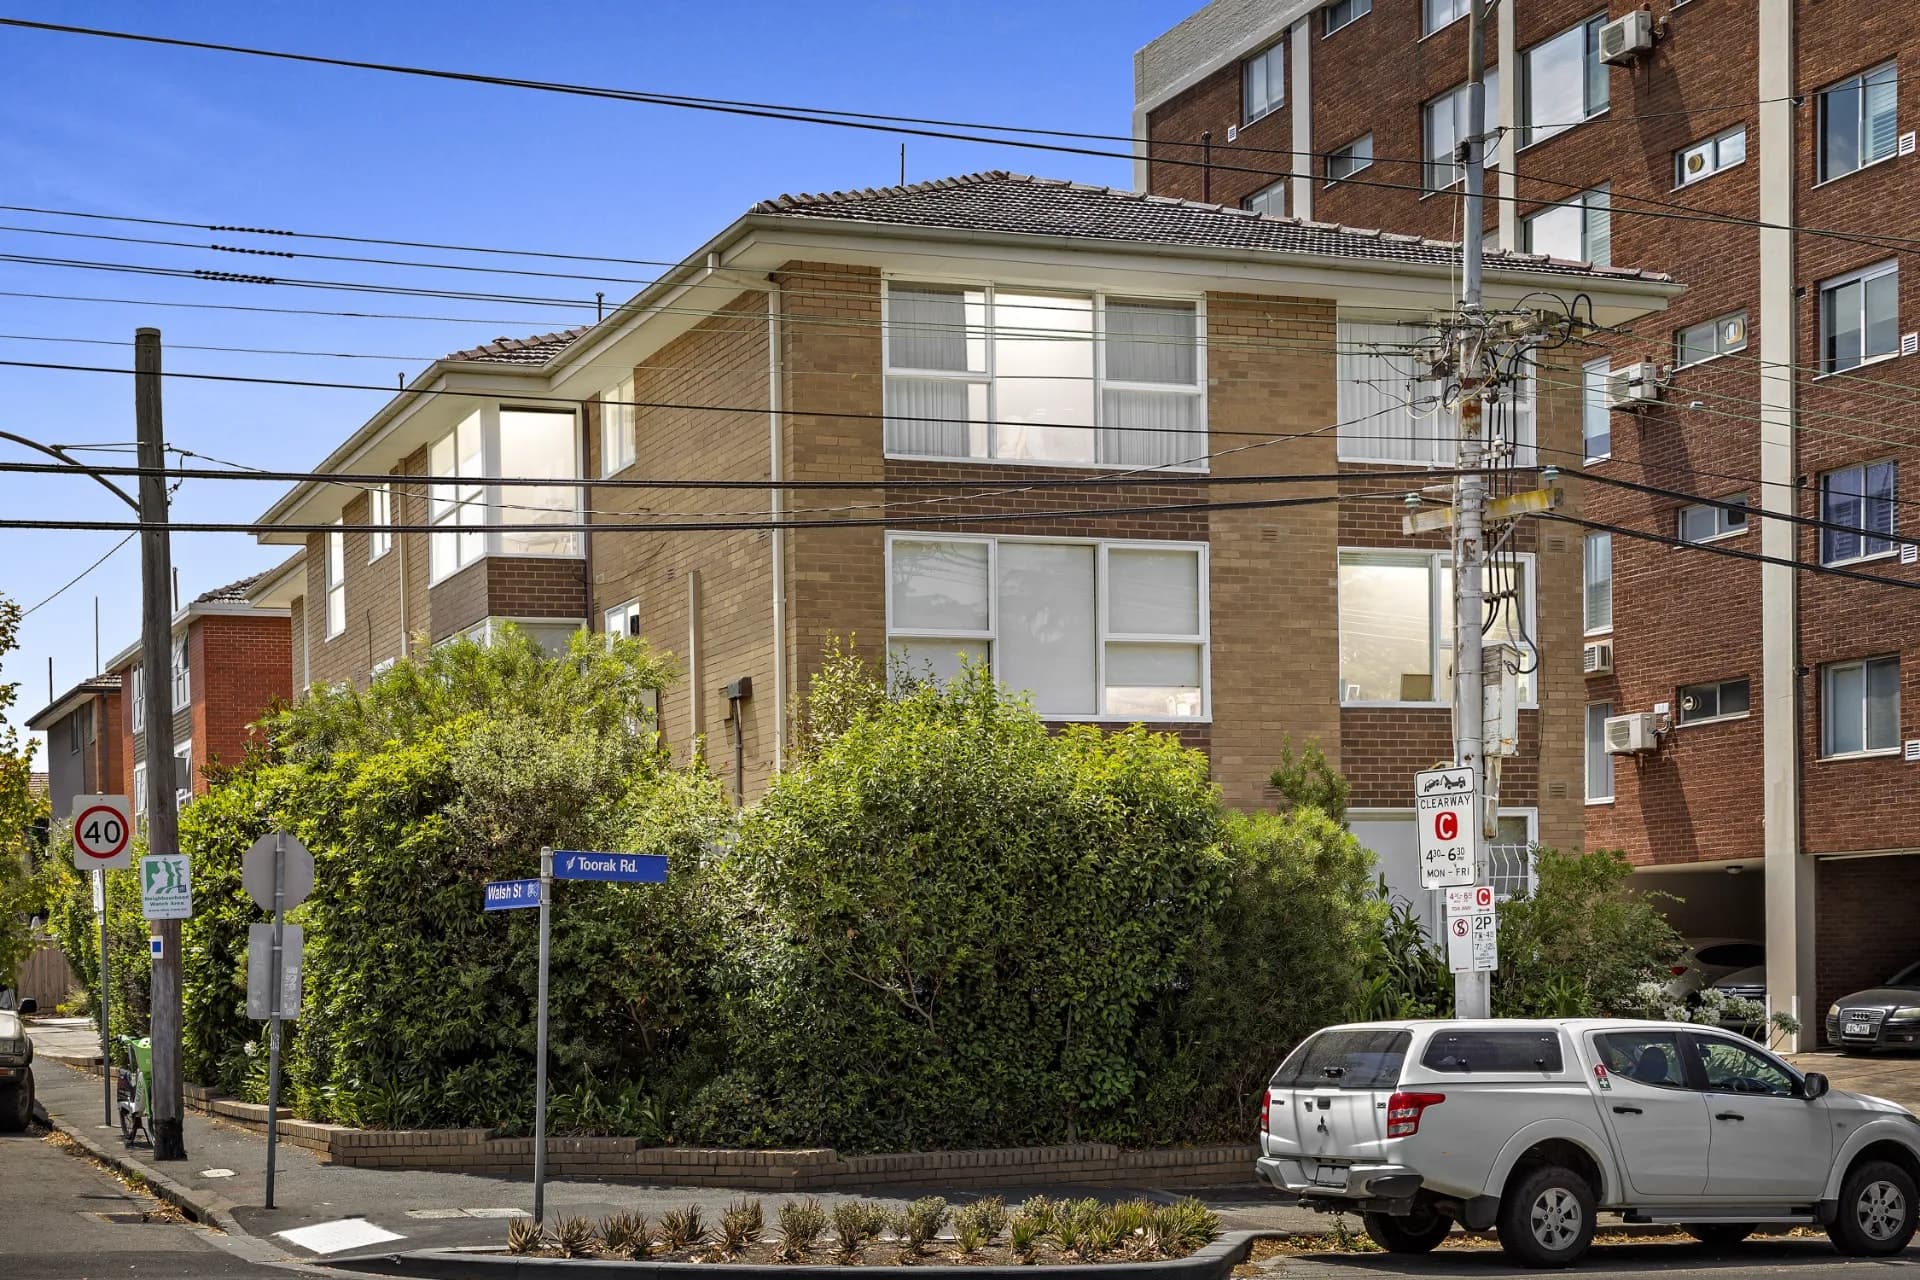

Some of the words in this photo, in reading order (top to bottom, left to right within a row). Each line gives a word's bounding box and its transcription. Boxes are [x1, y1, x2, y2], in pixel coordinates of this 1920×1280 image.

[1420, 795, 1470, 809] CLEARWAY
[84, 820, 121, 844] 40
[1440, 814, 1453, 838] C
[578, 857, 616, 872] Toorak
[620, 858, 638, 873] Rd.
[1427, 869, 1445, 878] MON
[1456, 868, 1470, 877] FRI
[488, 885, 511, 900] Walsh
[513, 883, 522, 898] St
[1475, 916, 1492, 930] 2P
